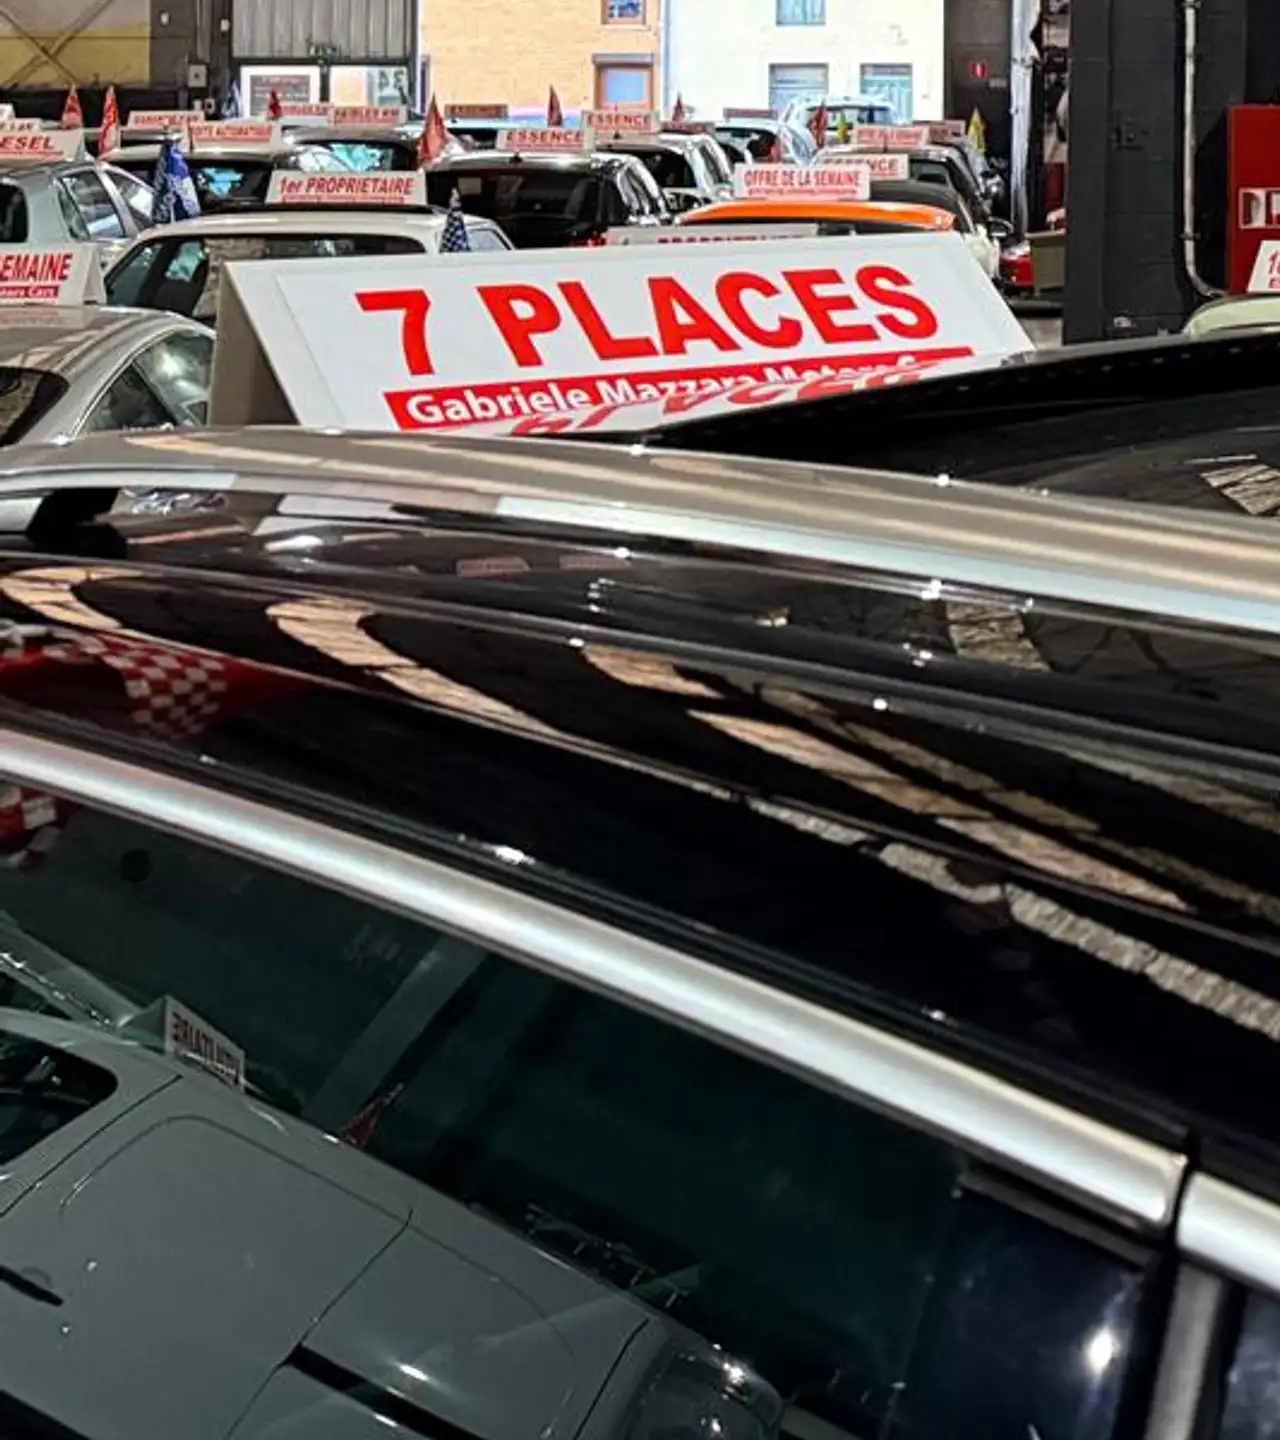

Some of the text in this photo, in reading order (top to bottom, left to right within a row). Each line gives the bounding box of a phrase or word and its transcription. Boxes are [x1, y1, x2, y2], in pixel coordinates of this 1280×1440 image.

[506, 129, 583, 143] ESSENCE
[281, 177, 414, 195] 1er PROPRIETAIRE
[355, 264, 939, 376] 7 PLACES
[406, 380, 592, 425] Gabriele
